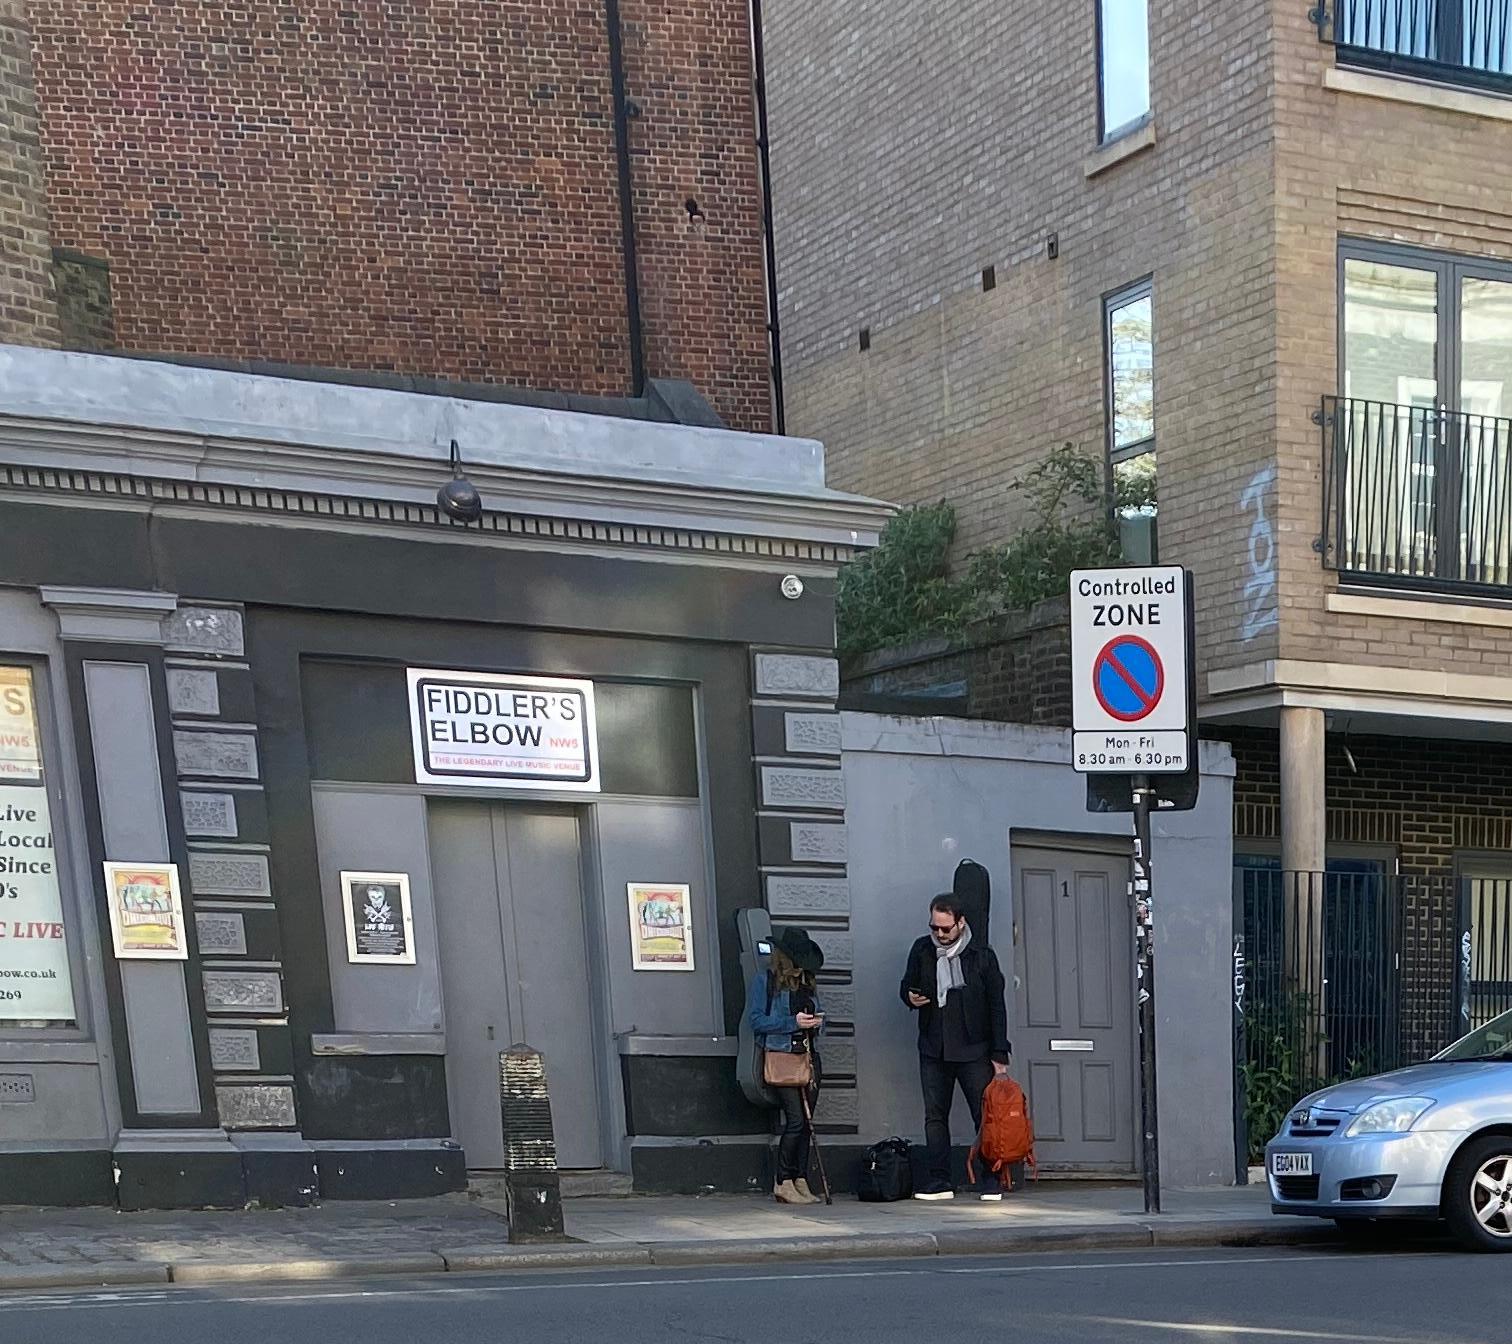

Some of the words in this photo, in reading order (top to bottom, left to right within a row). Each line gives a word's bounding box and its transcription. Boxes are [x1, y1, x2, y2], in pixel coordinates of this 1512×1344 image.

[1079, 576, 1175, 597] Controlled
[1093, 603, 1161, 626] ZONE
[427, 689, 576, 721] FIDDLER'S
[430, 719, 542, 747] ELBOW
[550, 738, 579, 749] NW5
[1106, 737, 1130, 749] Mon
[1140, 737, 1155, 748] Fri
[434, 756, 449, 765] THE
[453, 757, 504, 768] LEGENDARY
[1079, 753, 1106, 765] 8.30
[1109, 756, 1126, 764] am
[1165, 754, 1182, 766] pm
[1060, 880, 1070, 898] 1
[13, 922, 63, 938] LIVE
